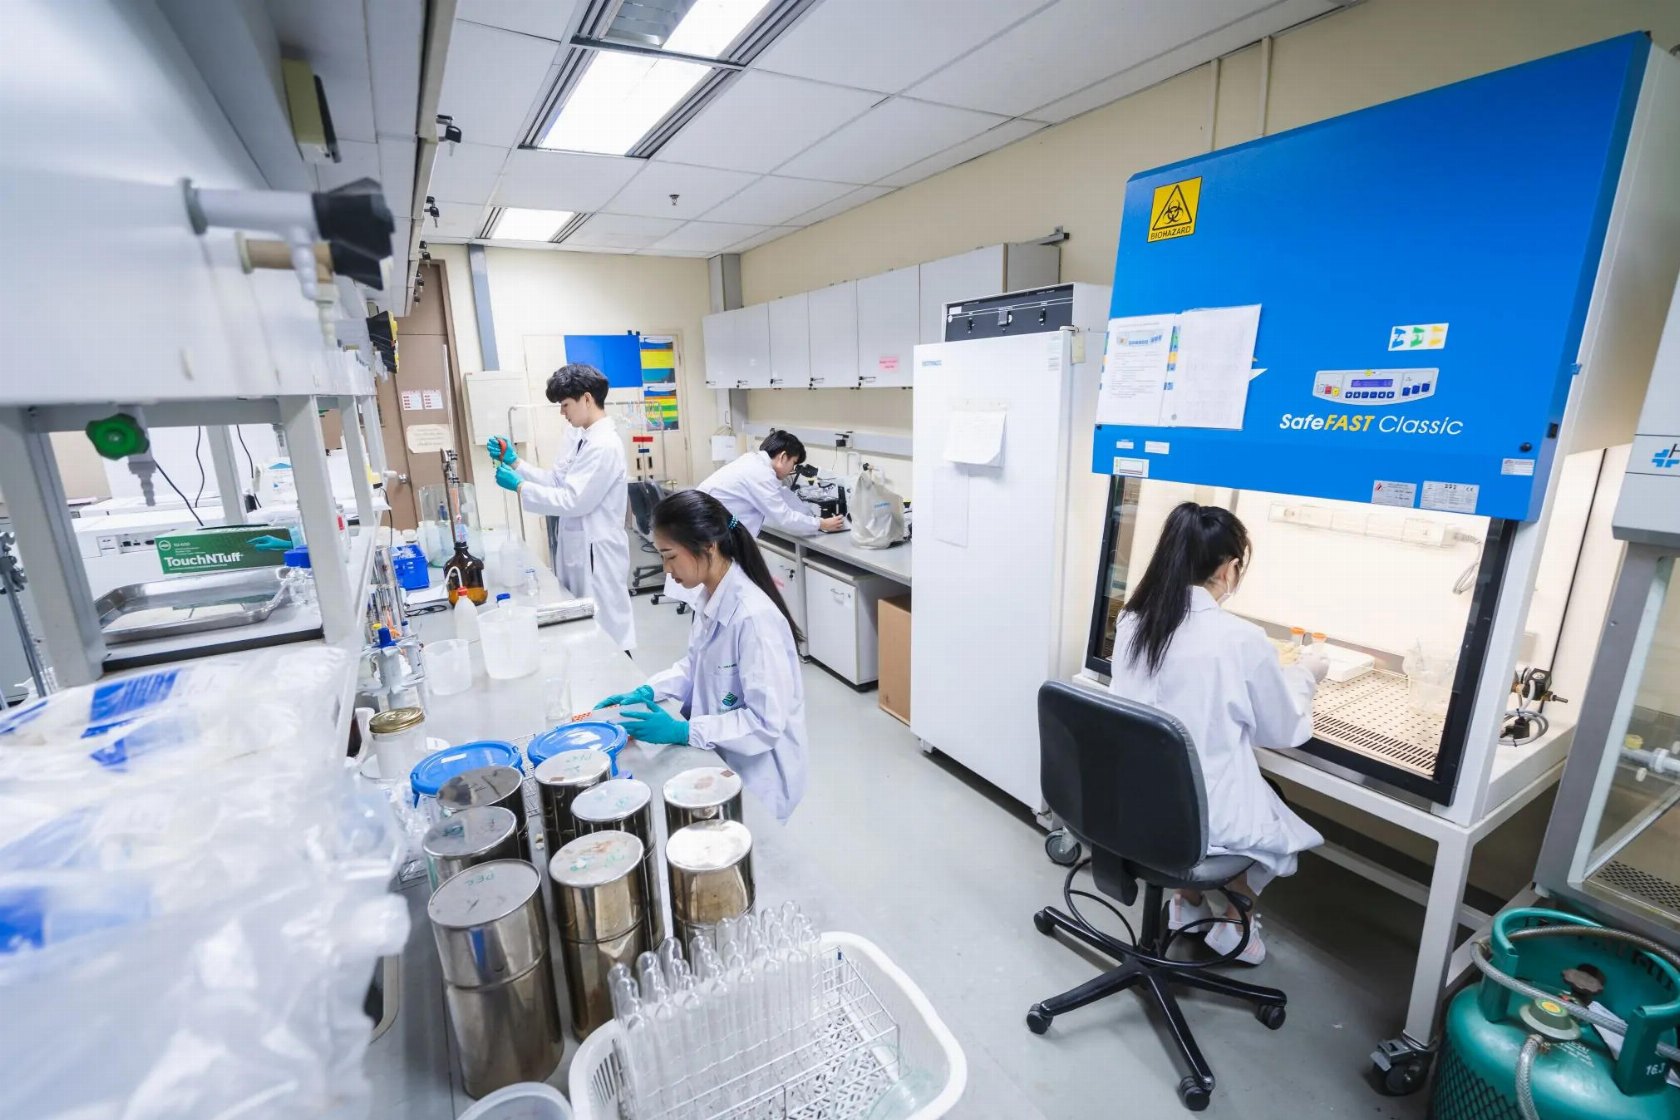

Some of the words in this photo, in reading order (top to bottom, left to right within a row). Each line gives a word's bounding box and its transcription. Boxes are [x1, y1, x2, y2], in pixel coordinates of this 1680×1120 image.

[1150, 226, 1192, 240] BIOHAZARD
[1279, 413, 1375, 432] SafeFAST
[1378, 415, 1464, 435] Classic
[163, 551, 242, 567] TouchNTuff
